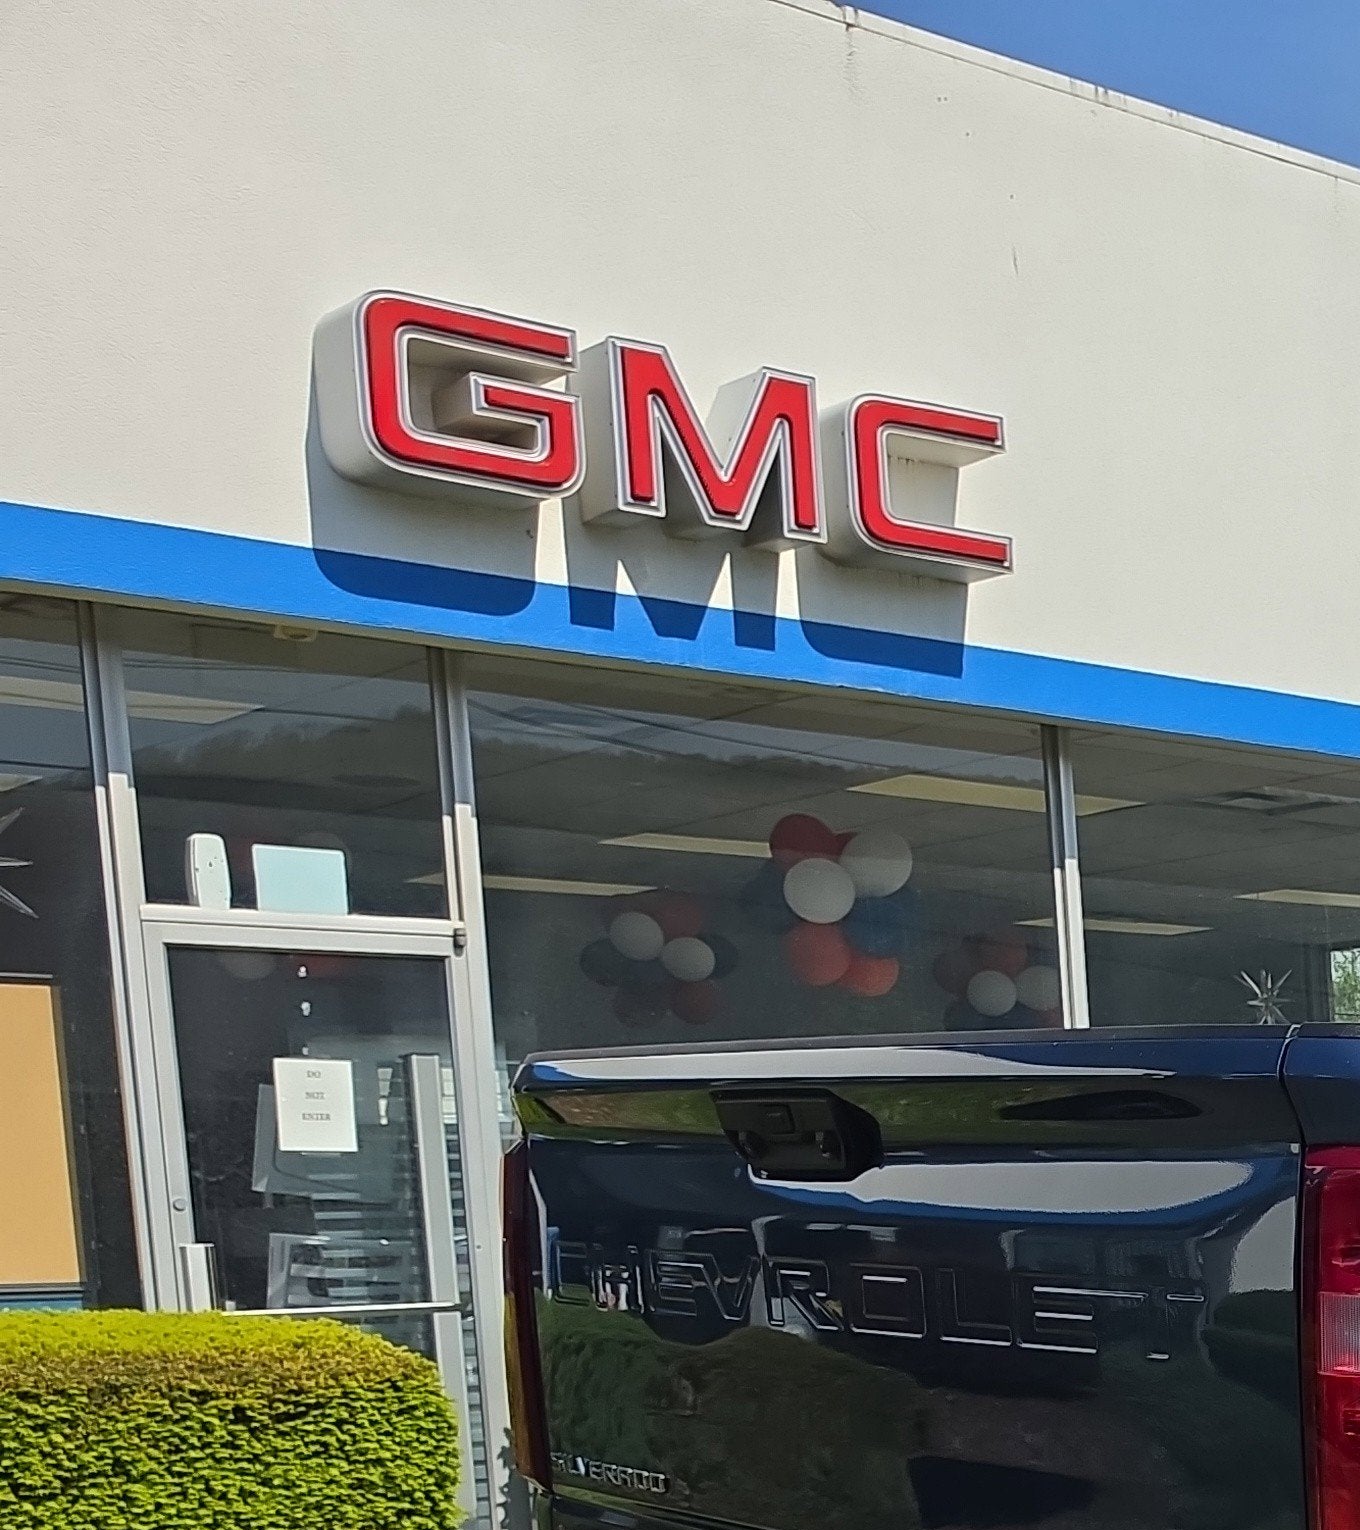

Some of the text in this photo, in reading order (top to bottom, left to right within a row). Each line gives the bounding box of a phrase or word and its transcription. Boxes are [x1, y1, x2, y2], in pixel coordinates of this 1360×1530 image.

[335, 289, 1014, 580] GMC
[554, 1238, 1204, 1362] CHEVROLET
[550, 1451, 666, 1493] SILVERADO
